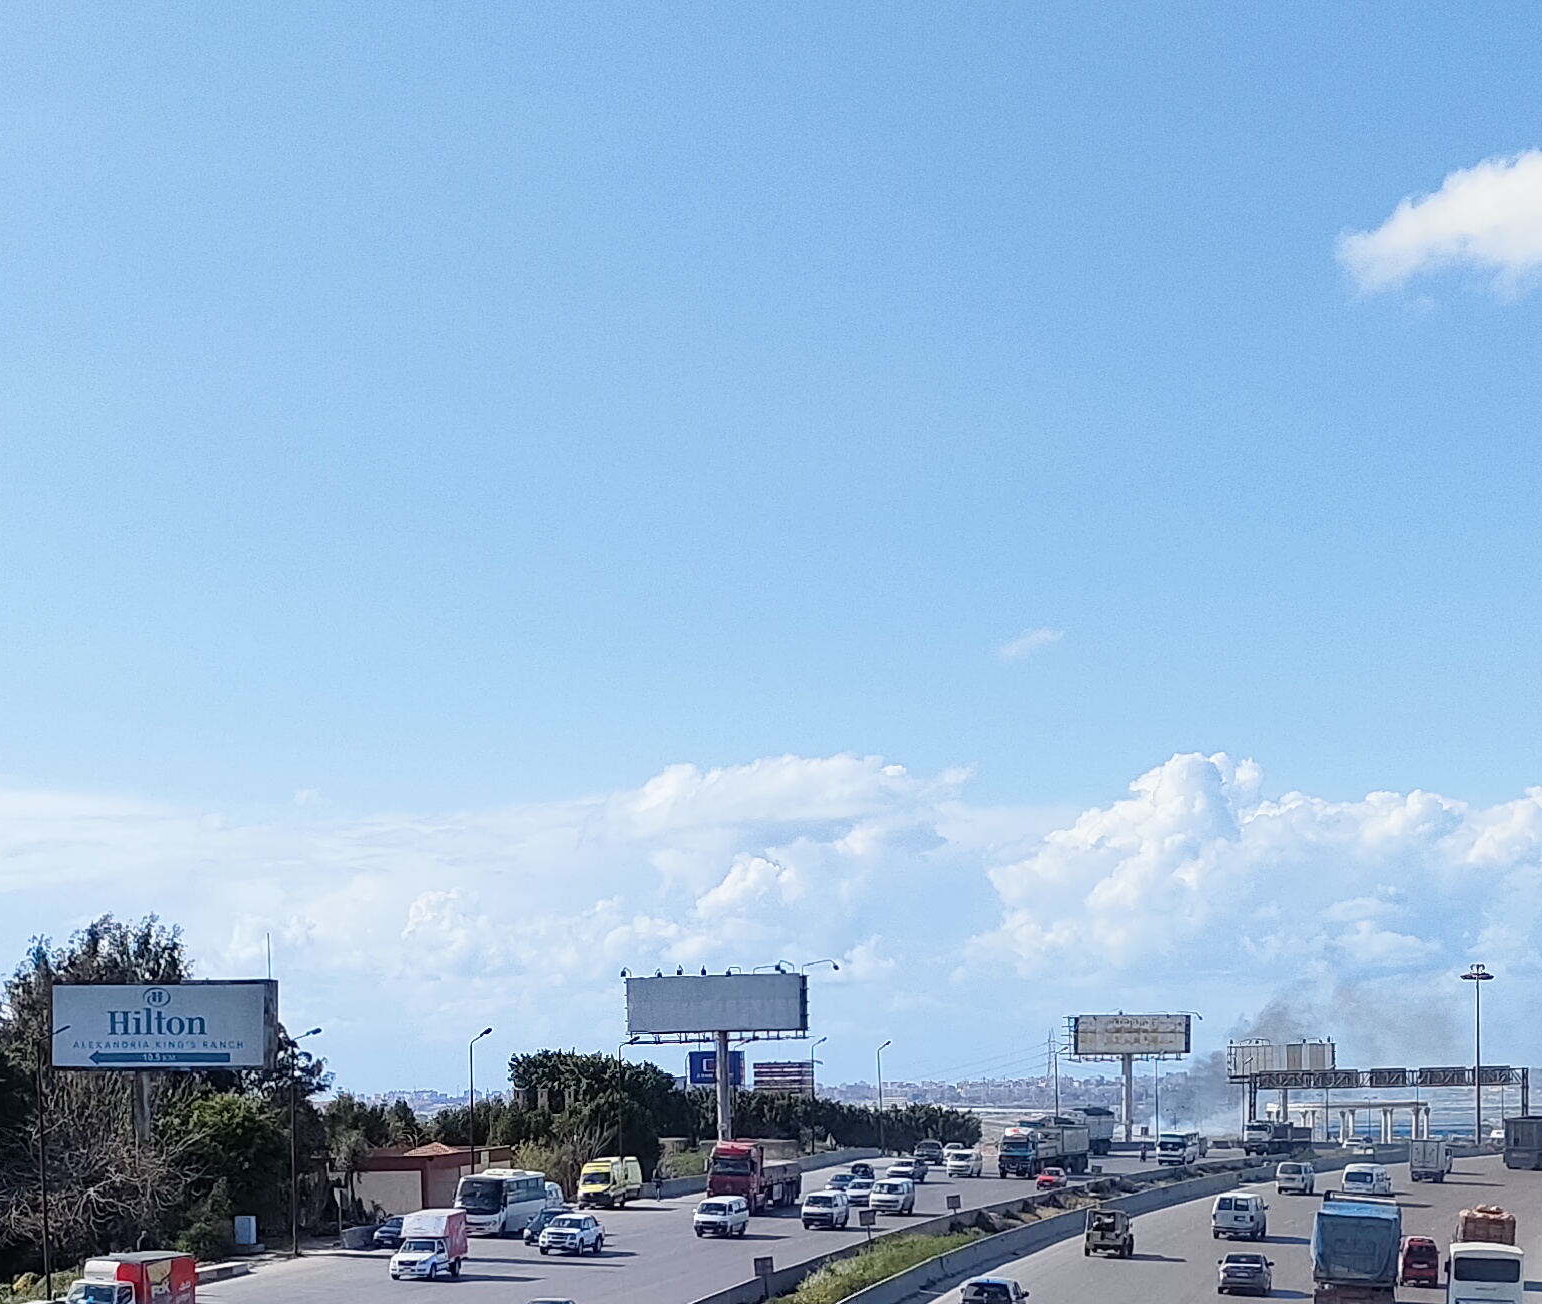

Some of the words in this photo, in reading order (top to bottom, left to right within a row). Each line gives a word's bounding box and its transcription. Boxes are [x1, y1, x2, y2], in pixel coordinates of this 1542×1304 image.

[107, 1008, 207, 1036] Hilton
[72, 1041, 150, 1049] ALEXANDRIA
[155, 1041, 197, 1049] KING'S
[203, 1041, 244, 1049] RANCH
[143, 1053, 161, 1062] 10.5
